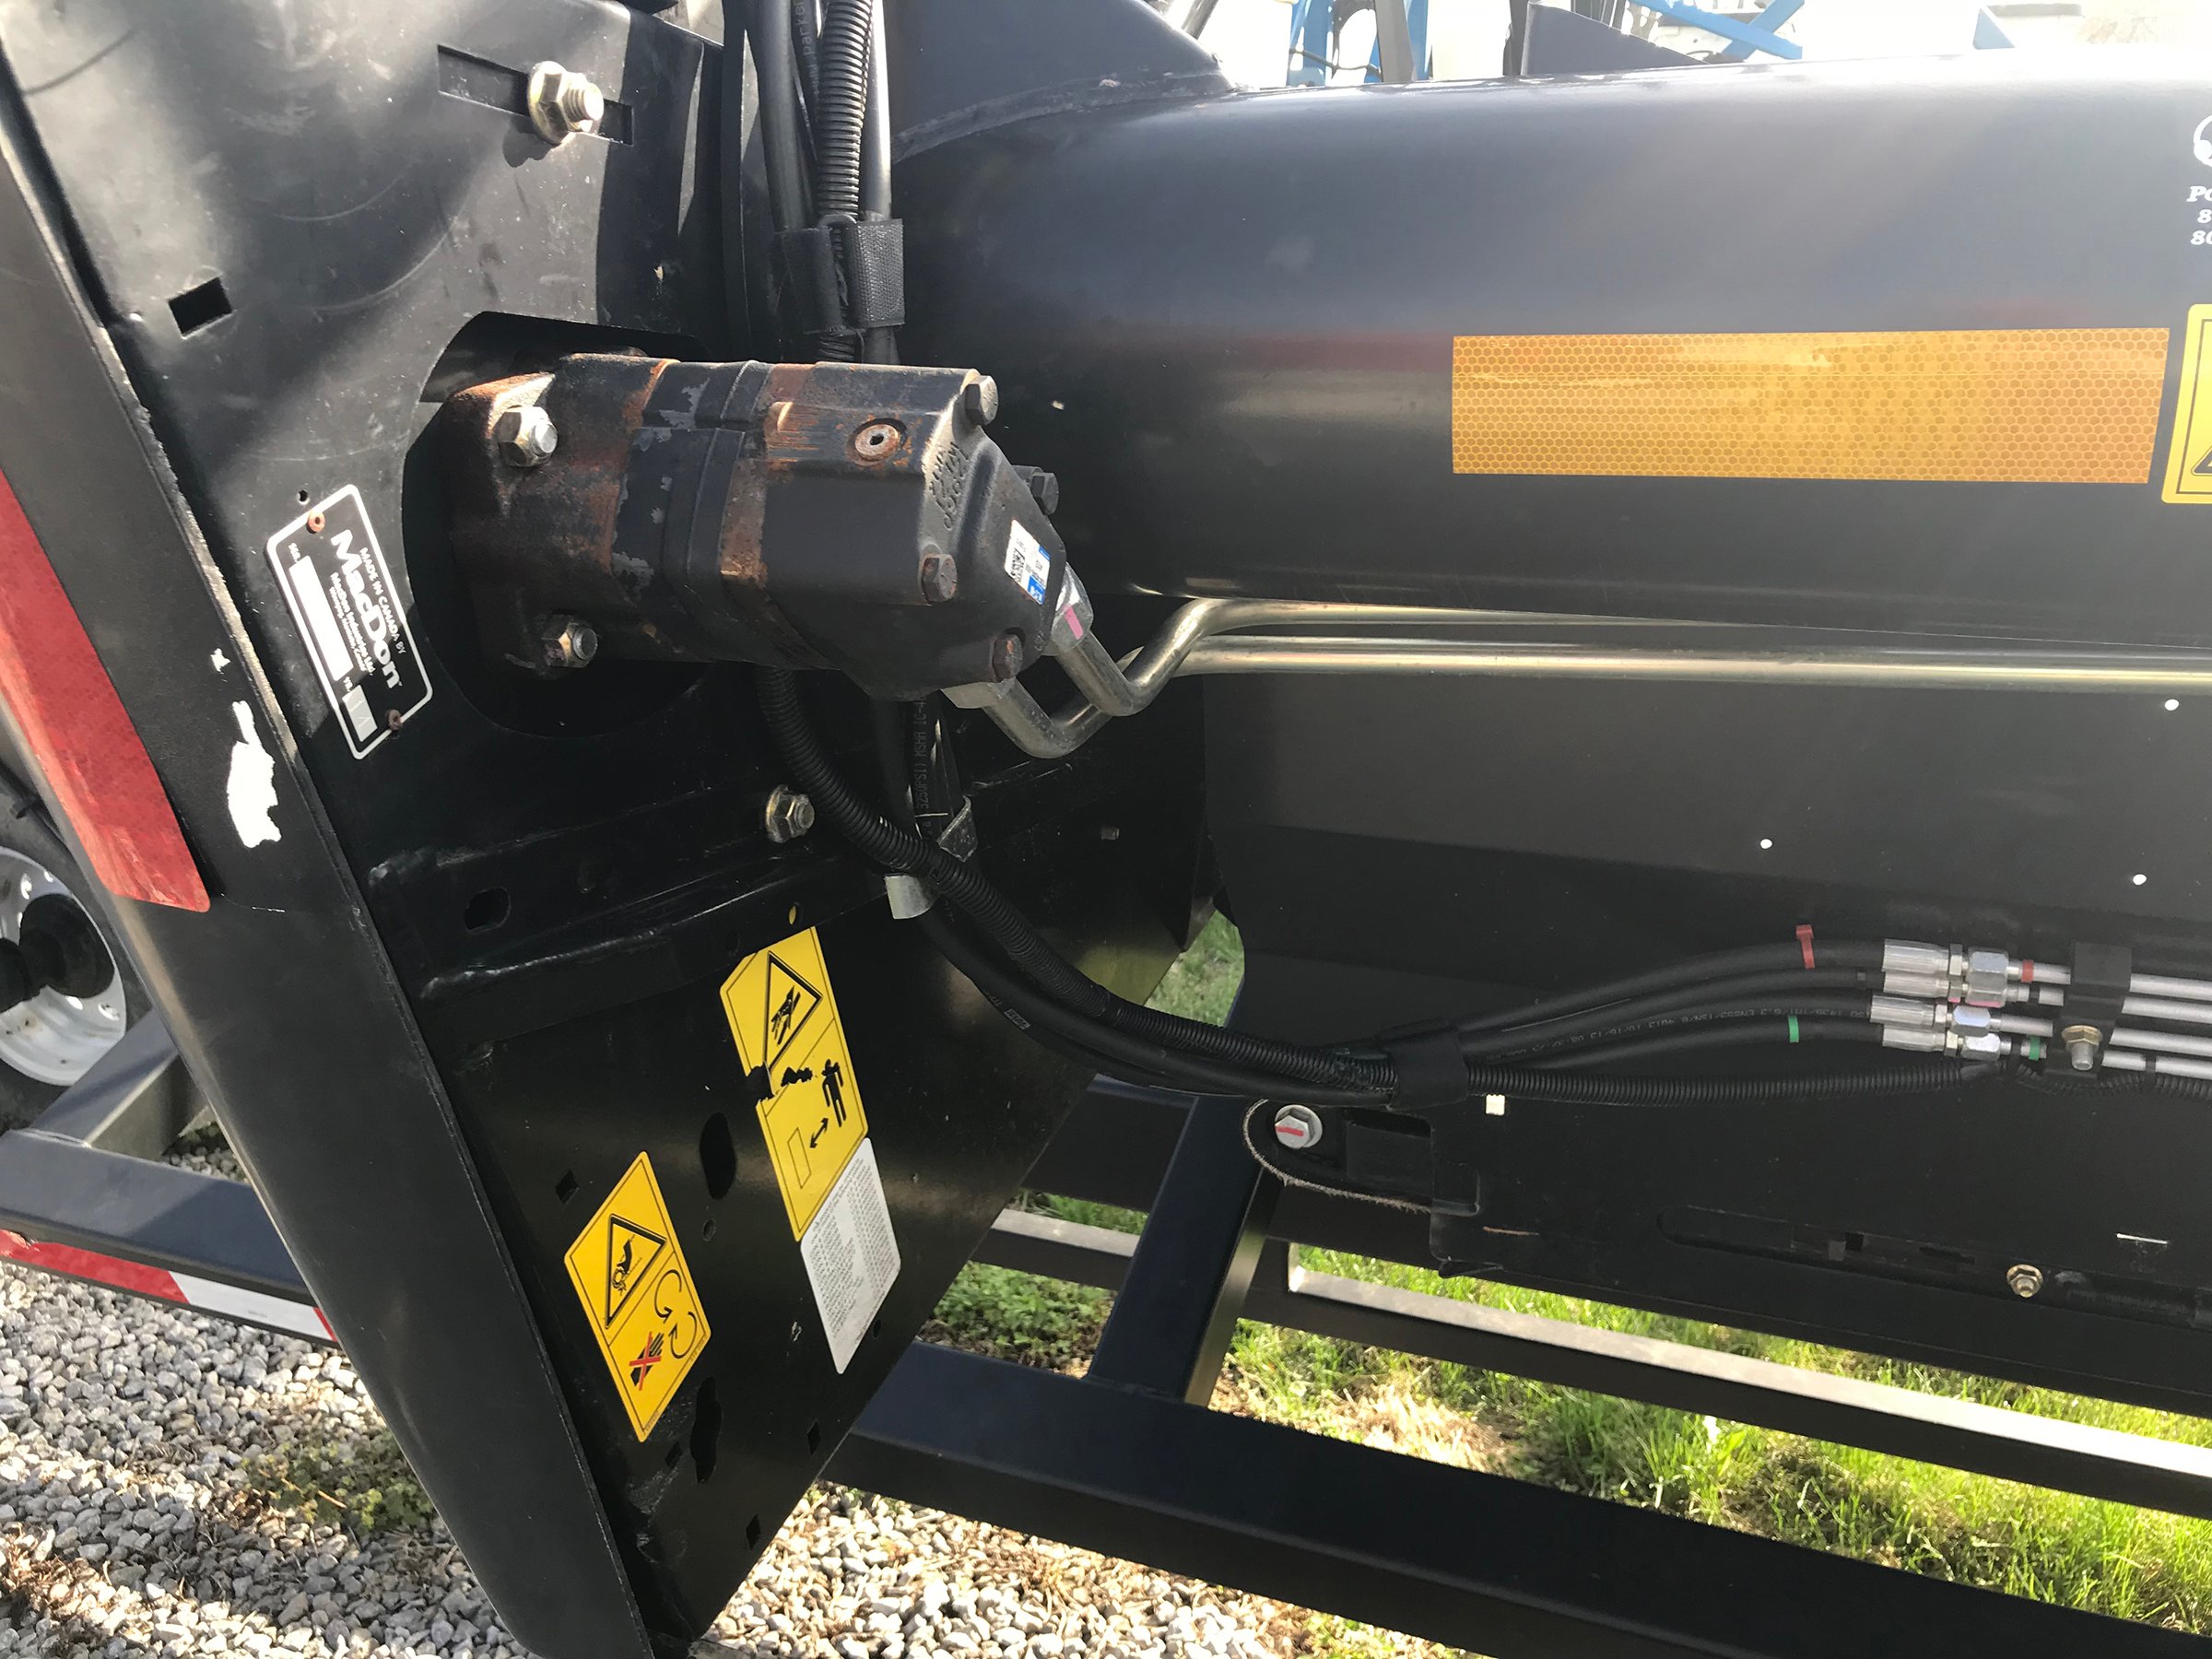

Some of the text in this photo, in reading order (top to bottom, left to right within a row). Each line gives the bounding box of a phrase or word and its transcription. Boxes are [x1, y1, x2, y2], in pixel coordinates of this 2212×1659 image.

[330, 528, 401, 689] MacDon
[359, 547, 406, 655] MADE IN CANADA BY
